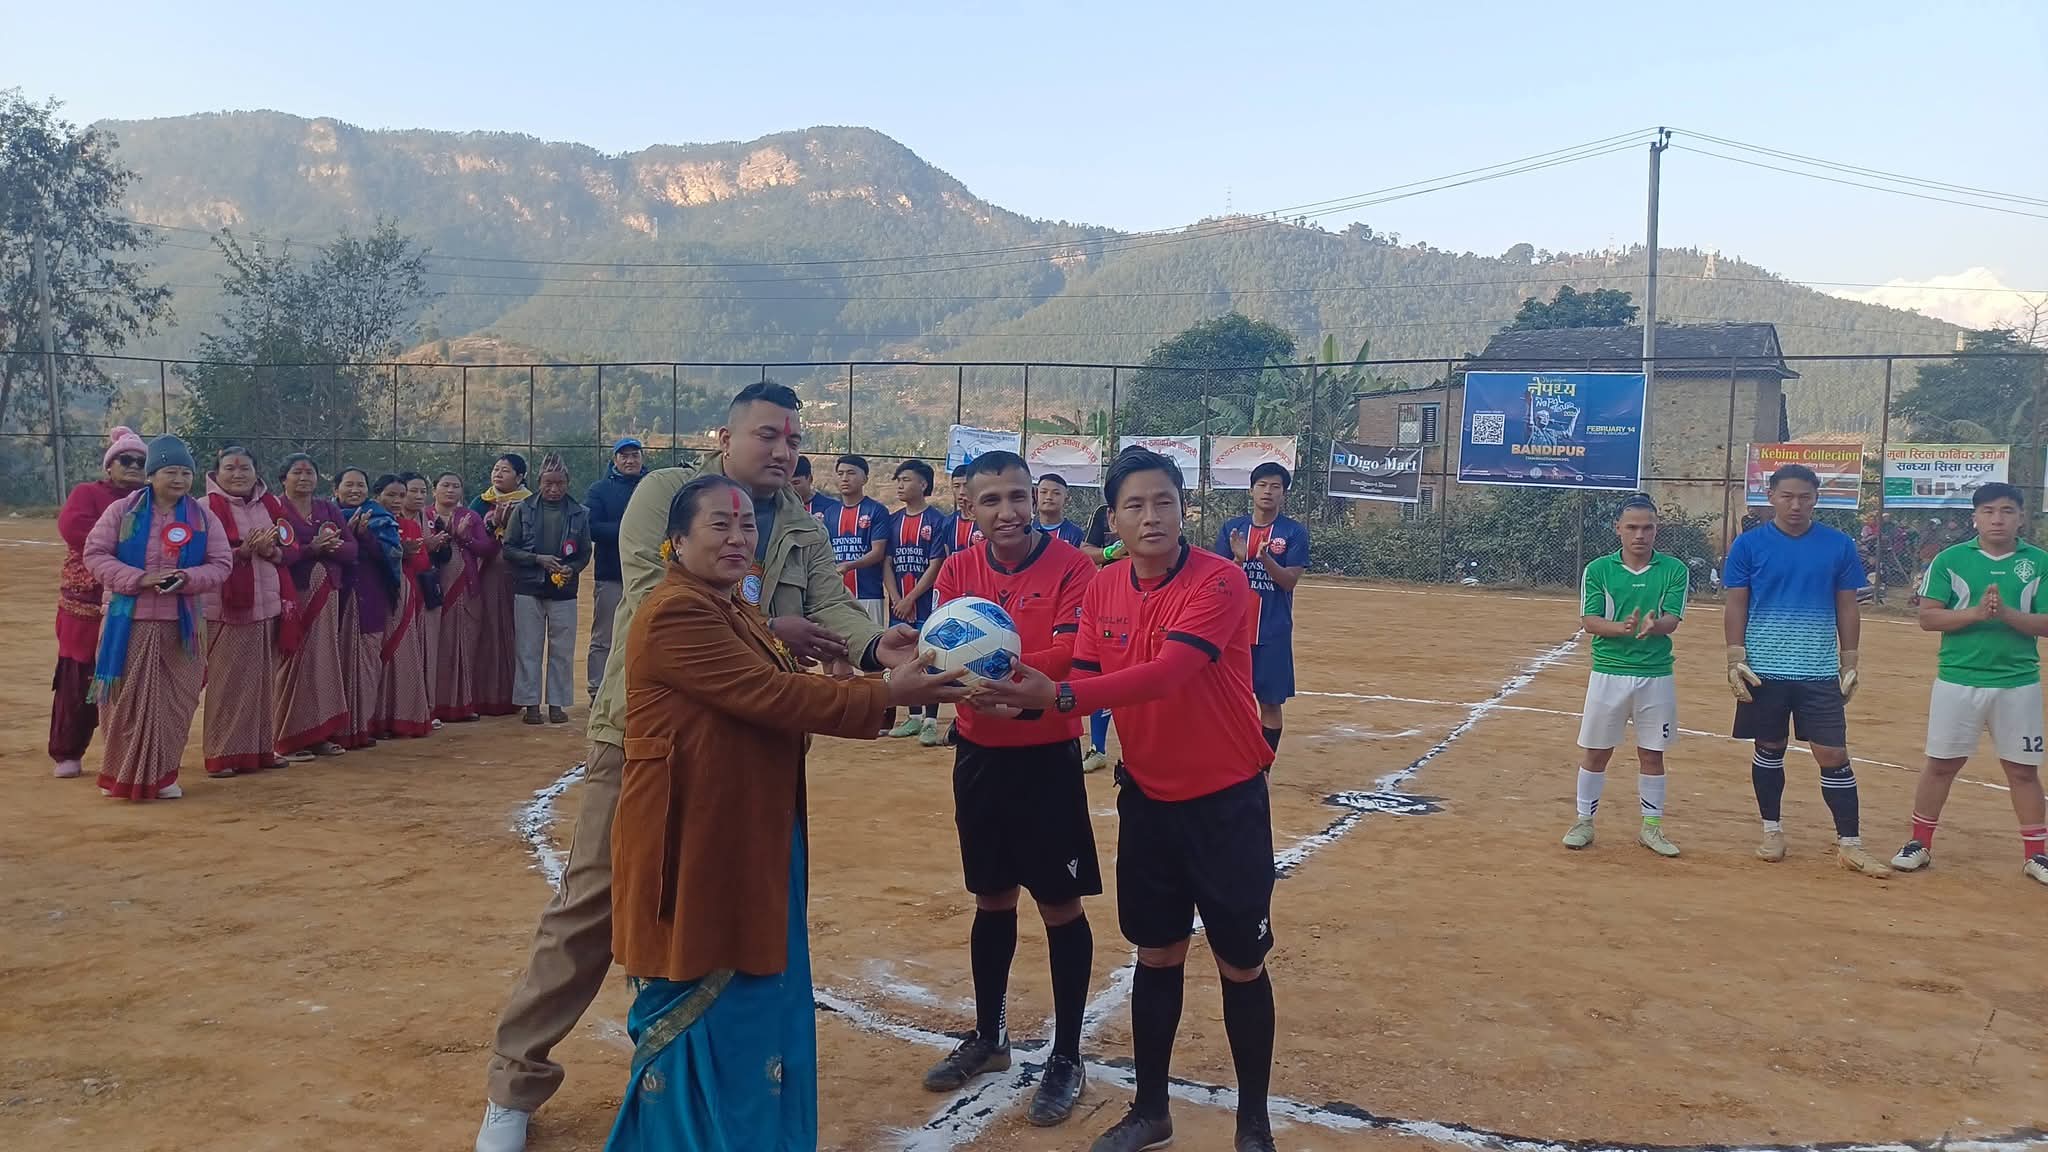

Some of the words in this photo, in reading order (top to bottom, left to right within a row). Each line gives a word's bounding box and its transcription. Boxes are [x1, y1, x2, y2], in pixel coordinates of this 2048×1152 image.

[1528, 376, 1576, 396] नेपथ्य
[1511, 444, 1586, 456] BANDIPUR
[1760, 448, 1799, 460] Kebina
[1803, 448, 1860, 461] Collection
[1347, 454, 1379, 472] Digo
[1384, 457, 1417, 471] Mart
[1965, 463, 1994, 472] पसल
[832, 537, 862, 545] SPONSOR
[1251, 580, 1274, 591] RANA
[1662, 722, 1670, 738] 5
[2022, 736, 2043, 752] 12
